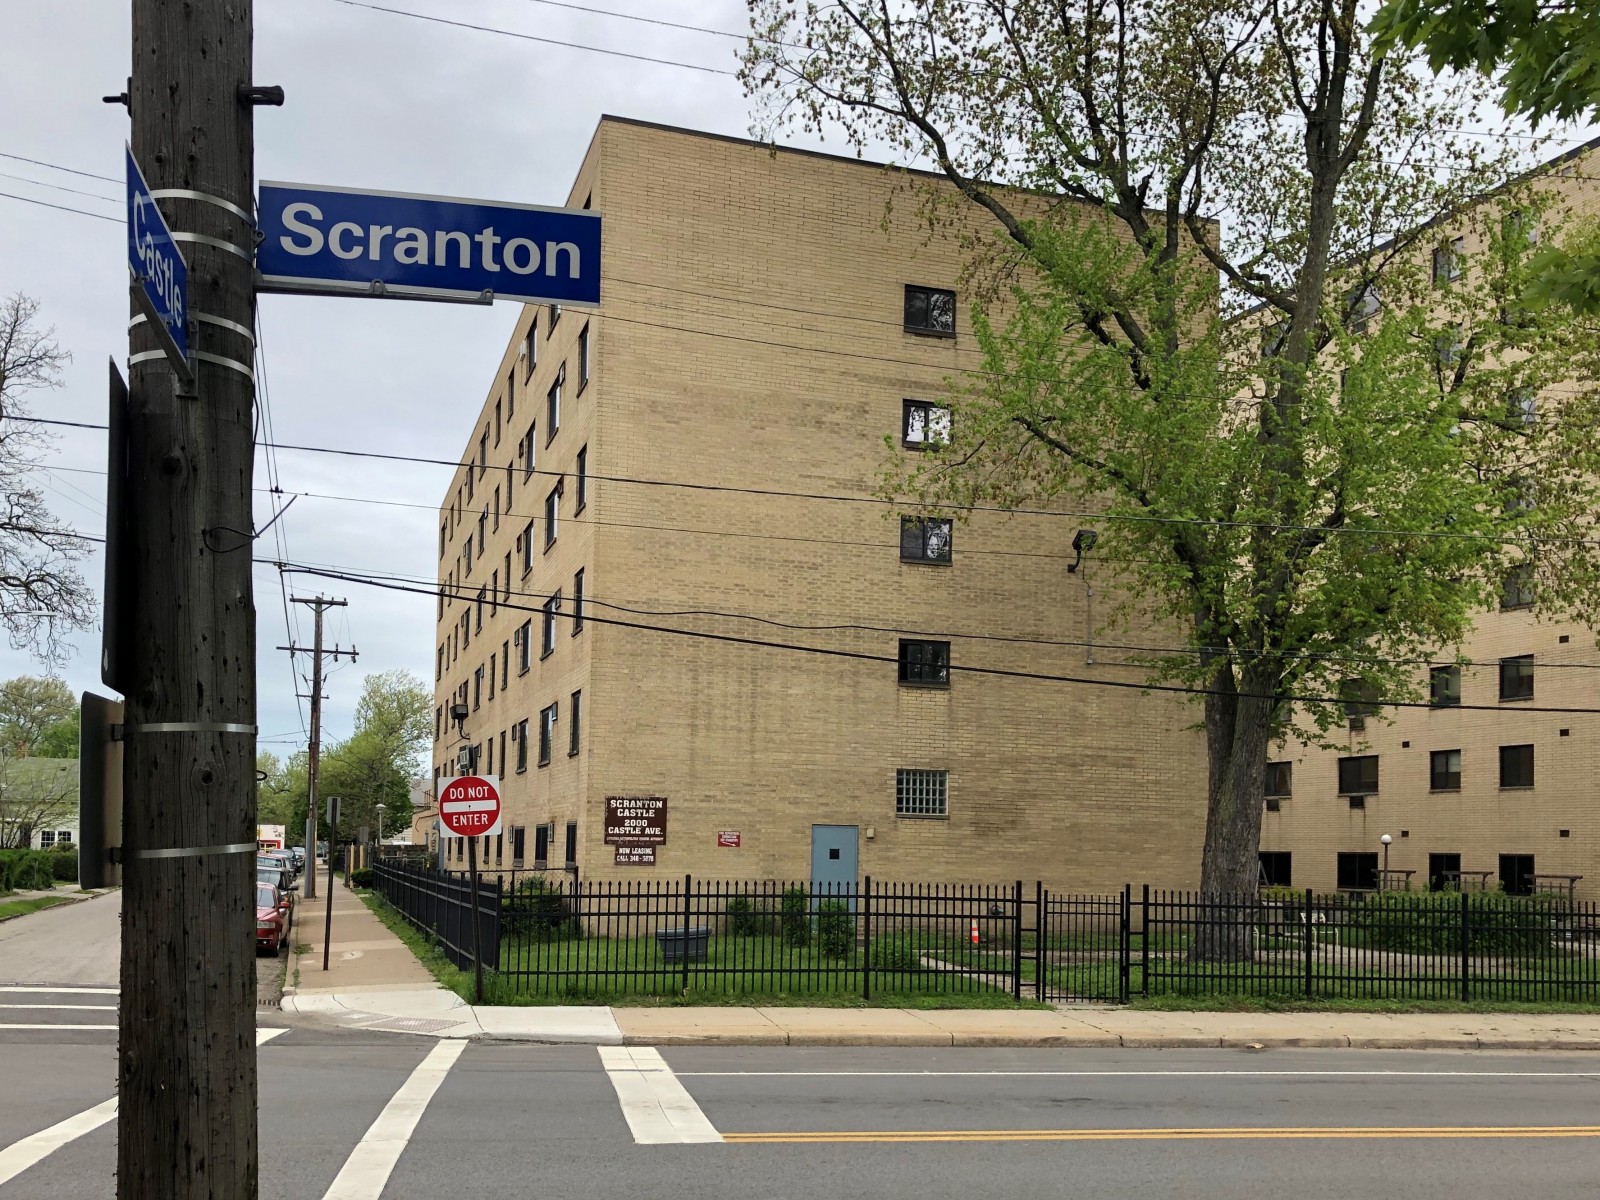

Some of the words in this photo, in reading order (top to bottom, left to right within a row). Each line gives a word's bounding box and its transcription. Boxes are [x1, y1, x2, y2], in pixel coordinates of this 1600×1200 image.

[279, 202, 581, 280] Scranton
[133, 189, 182, 329] Castle
[450, 787, 464, 799] DO
[468, 786, 489, 798] NOT
[610, 799, 663, 808] SCRANTON
[617, 808, 655, 817] CASTLE
[452, 813, 489, 826] ENTER
[624, 819, 648, 827] 2000
[608, 826, 642, 834] CASTLE
[644, 827, 664, 835] AVE.
